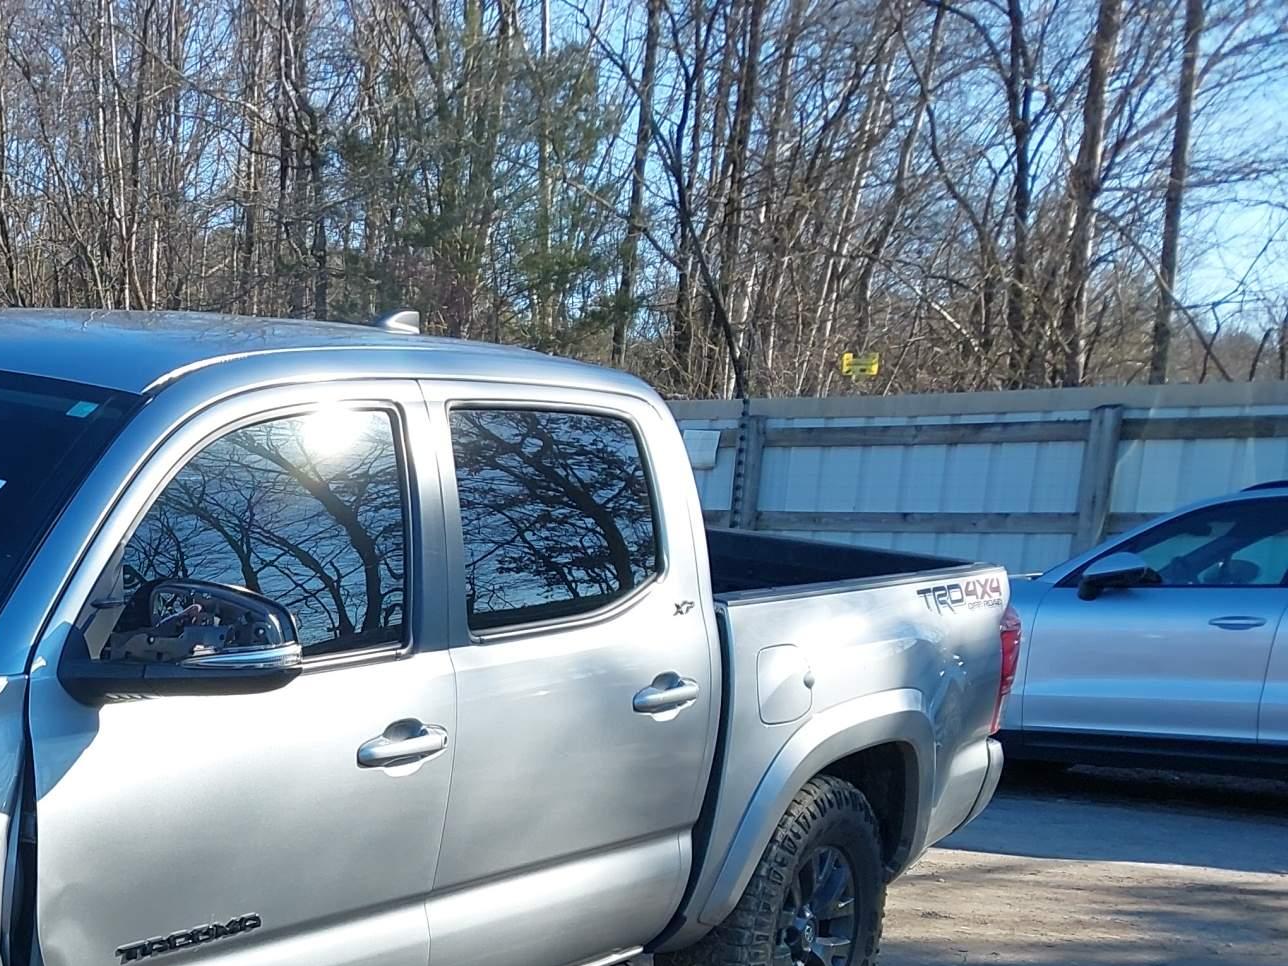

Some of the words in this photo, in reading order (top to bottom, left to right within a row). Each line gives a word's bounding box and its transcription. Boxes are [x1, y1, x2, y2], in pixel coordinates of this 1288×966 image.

[916, 583, 966, 615] TRD
[964, 578, 1002, 600] 4X4
[114, 911, 262, 965] TACOMA
